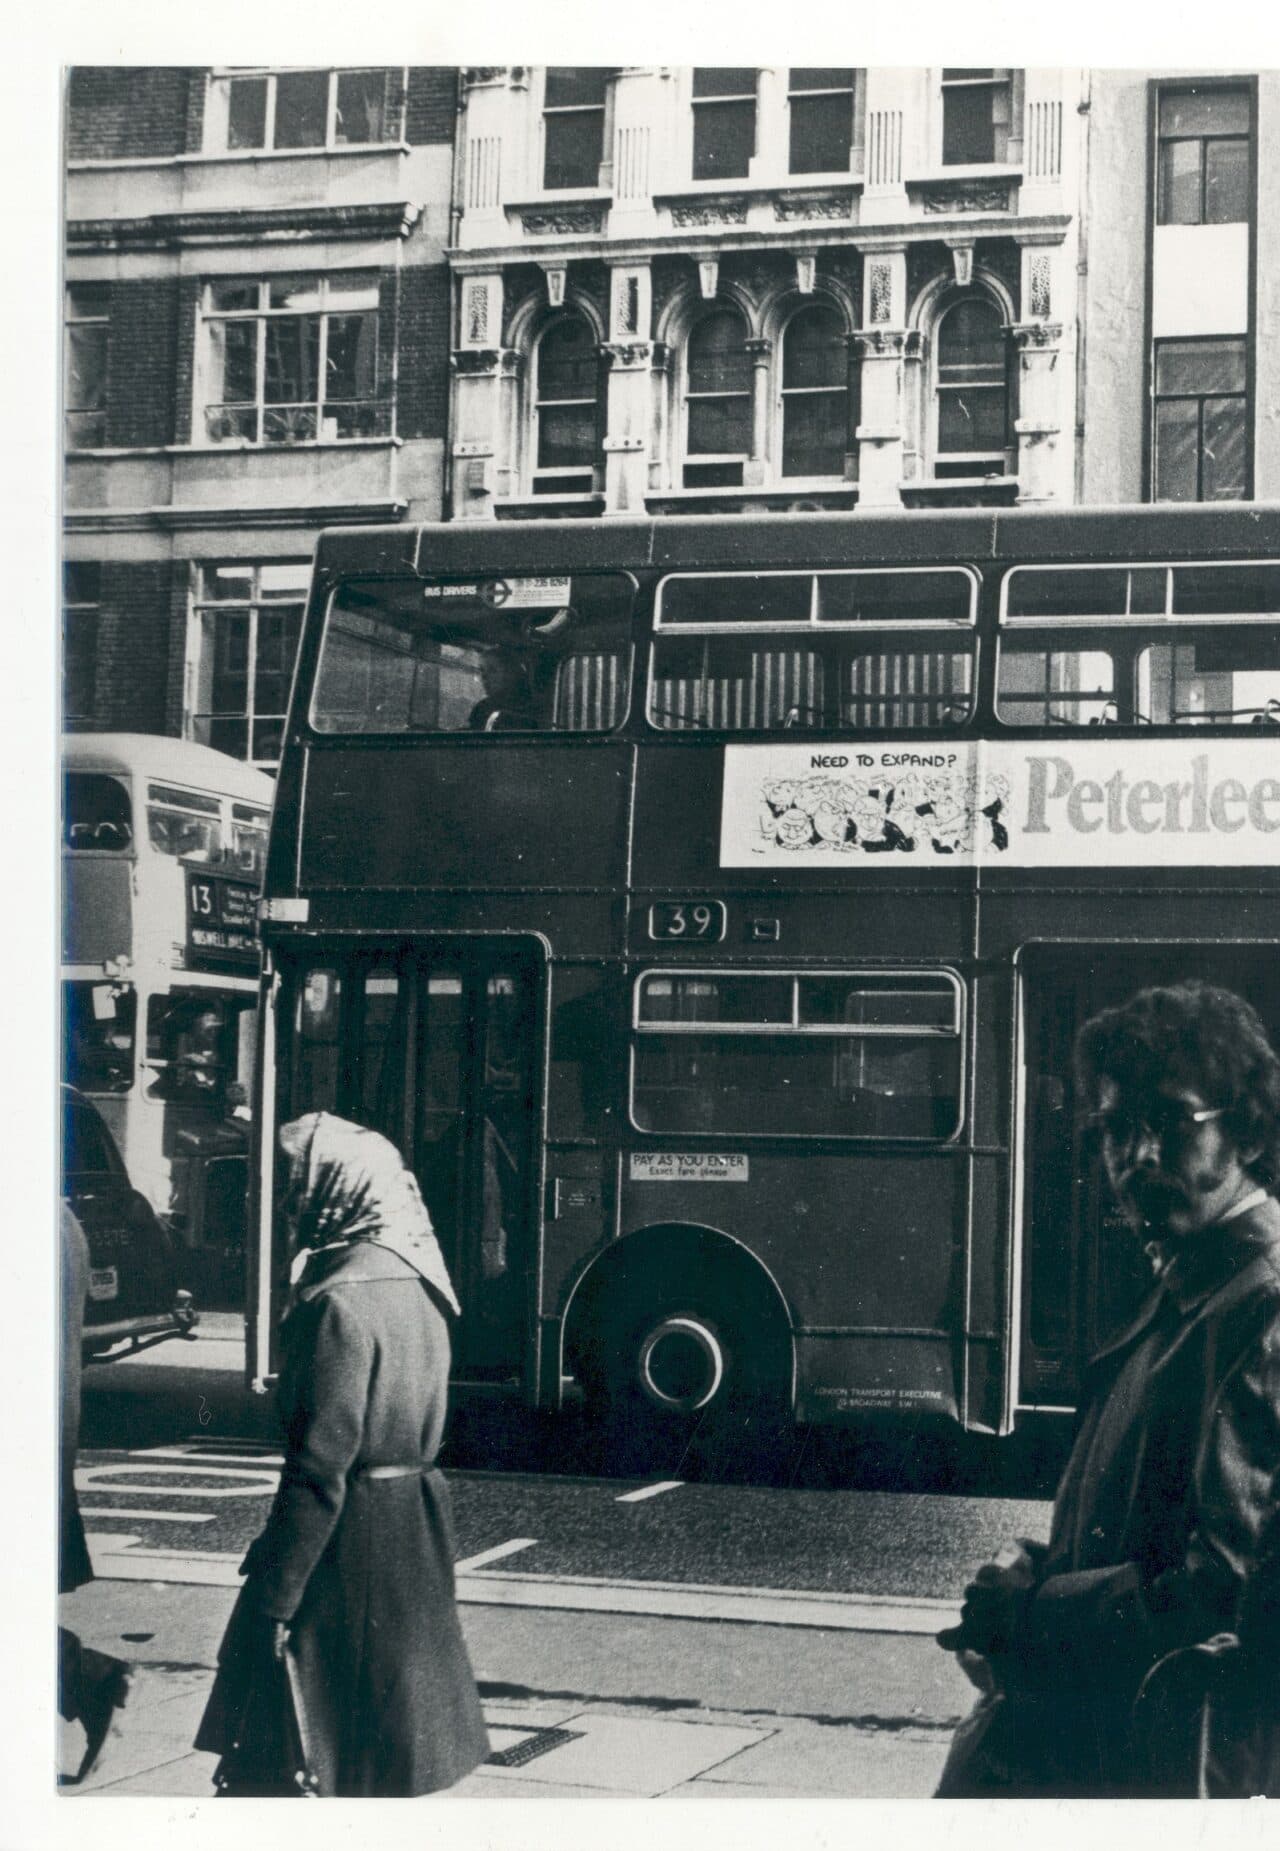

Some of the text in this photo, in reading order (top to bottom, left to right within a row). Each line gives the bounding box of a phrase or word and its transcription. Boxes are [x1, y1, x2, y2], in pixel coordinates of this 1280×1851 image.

[811, 753, 957, 768] NEED TO EXPAND?
[191, 884, 212, 914] 13
[667, 905, 711, 935] 39
[633, 1155, 745, 1167] PAY AS YOU ENTER
[815, 1386, 942, 1400] LONDON TRANSPORT EXECUTIVE
